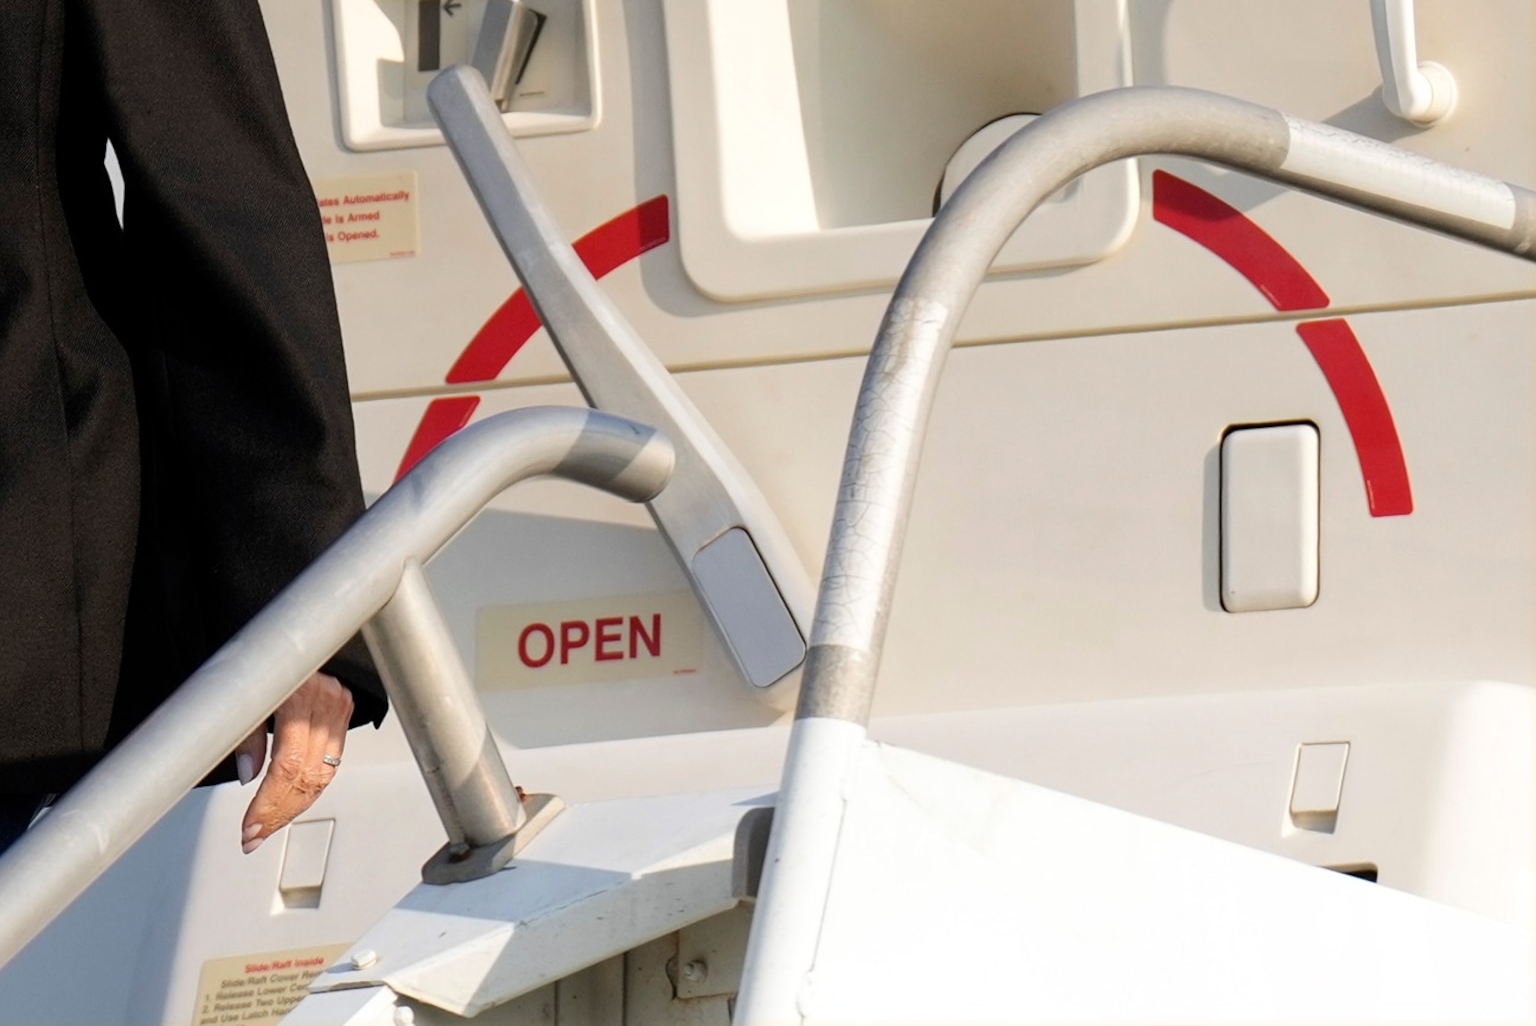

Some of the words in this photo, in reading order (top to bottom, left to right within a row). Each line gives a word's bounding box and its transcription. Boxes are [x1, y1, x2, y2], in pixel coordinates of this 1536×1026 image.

[343, 190, 410, 205] Automatically
[347, 211, 381, 223] Armed
[517, 613, 661, 668] OPEN
